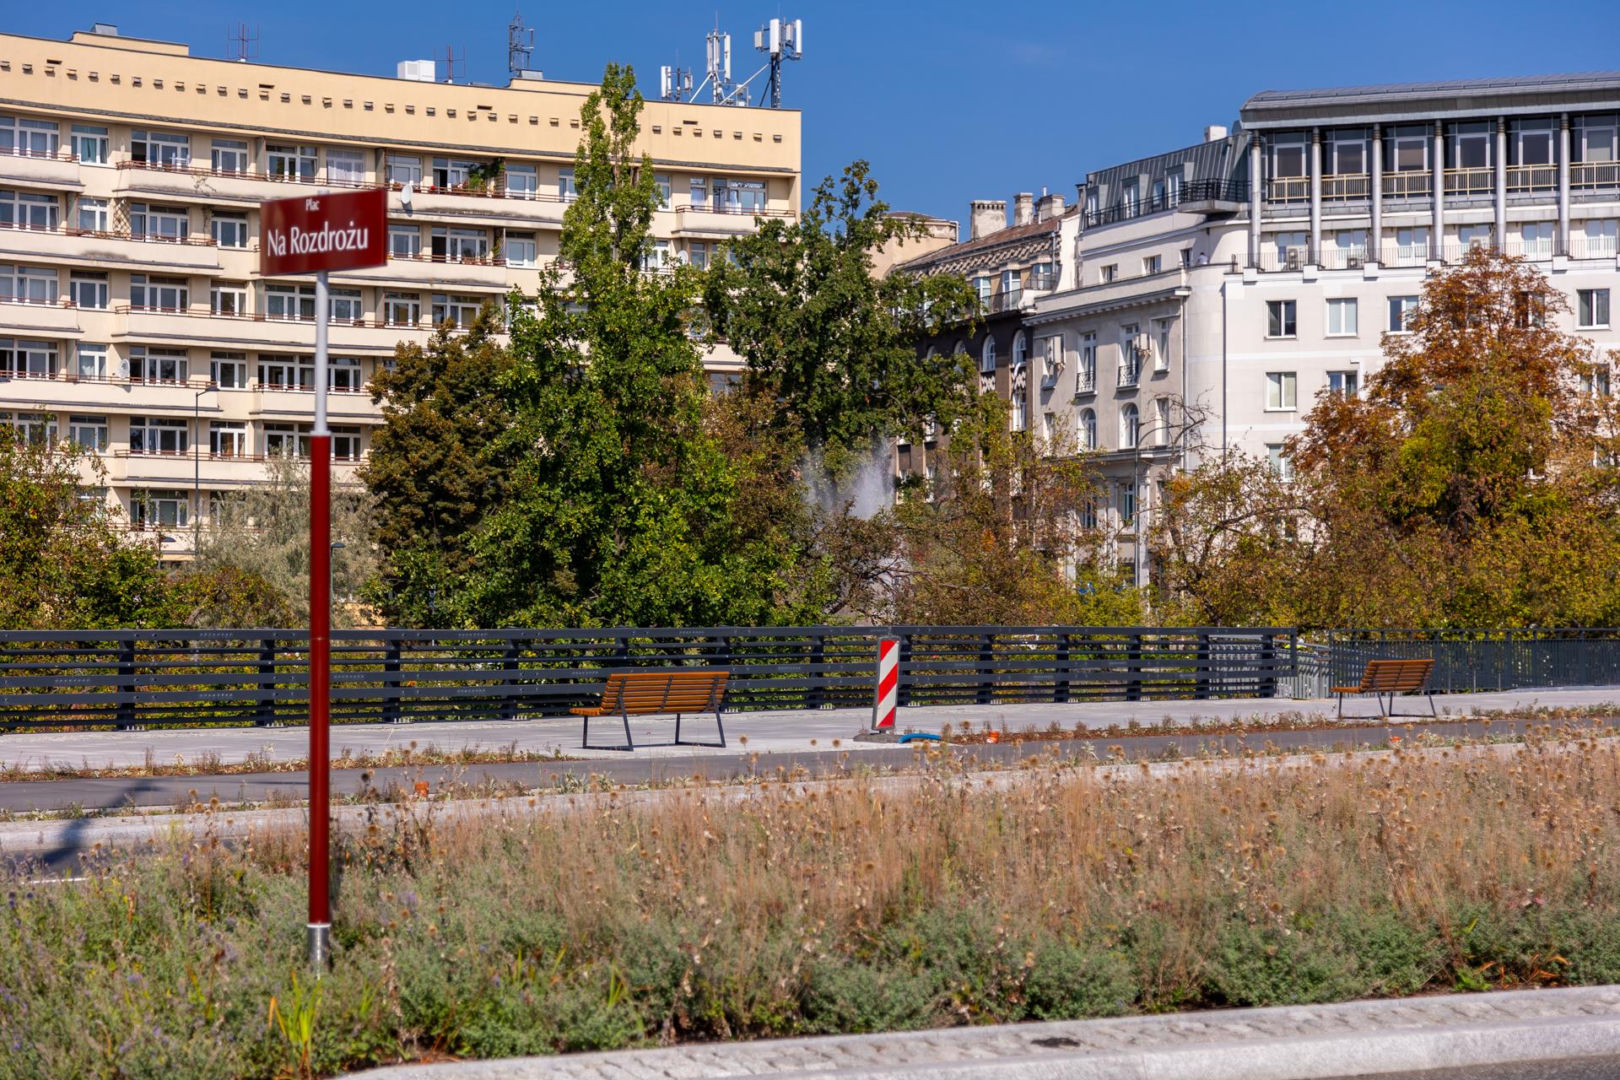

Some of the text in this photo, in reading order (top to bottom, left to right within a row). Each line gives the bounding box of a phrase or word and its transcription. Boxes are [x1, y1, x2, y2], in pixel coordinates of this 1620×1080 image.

[305, 198, 320, 211] Plac
[267, 220, 369, 256] Na Rozdrożu
